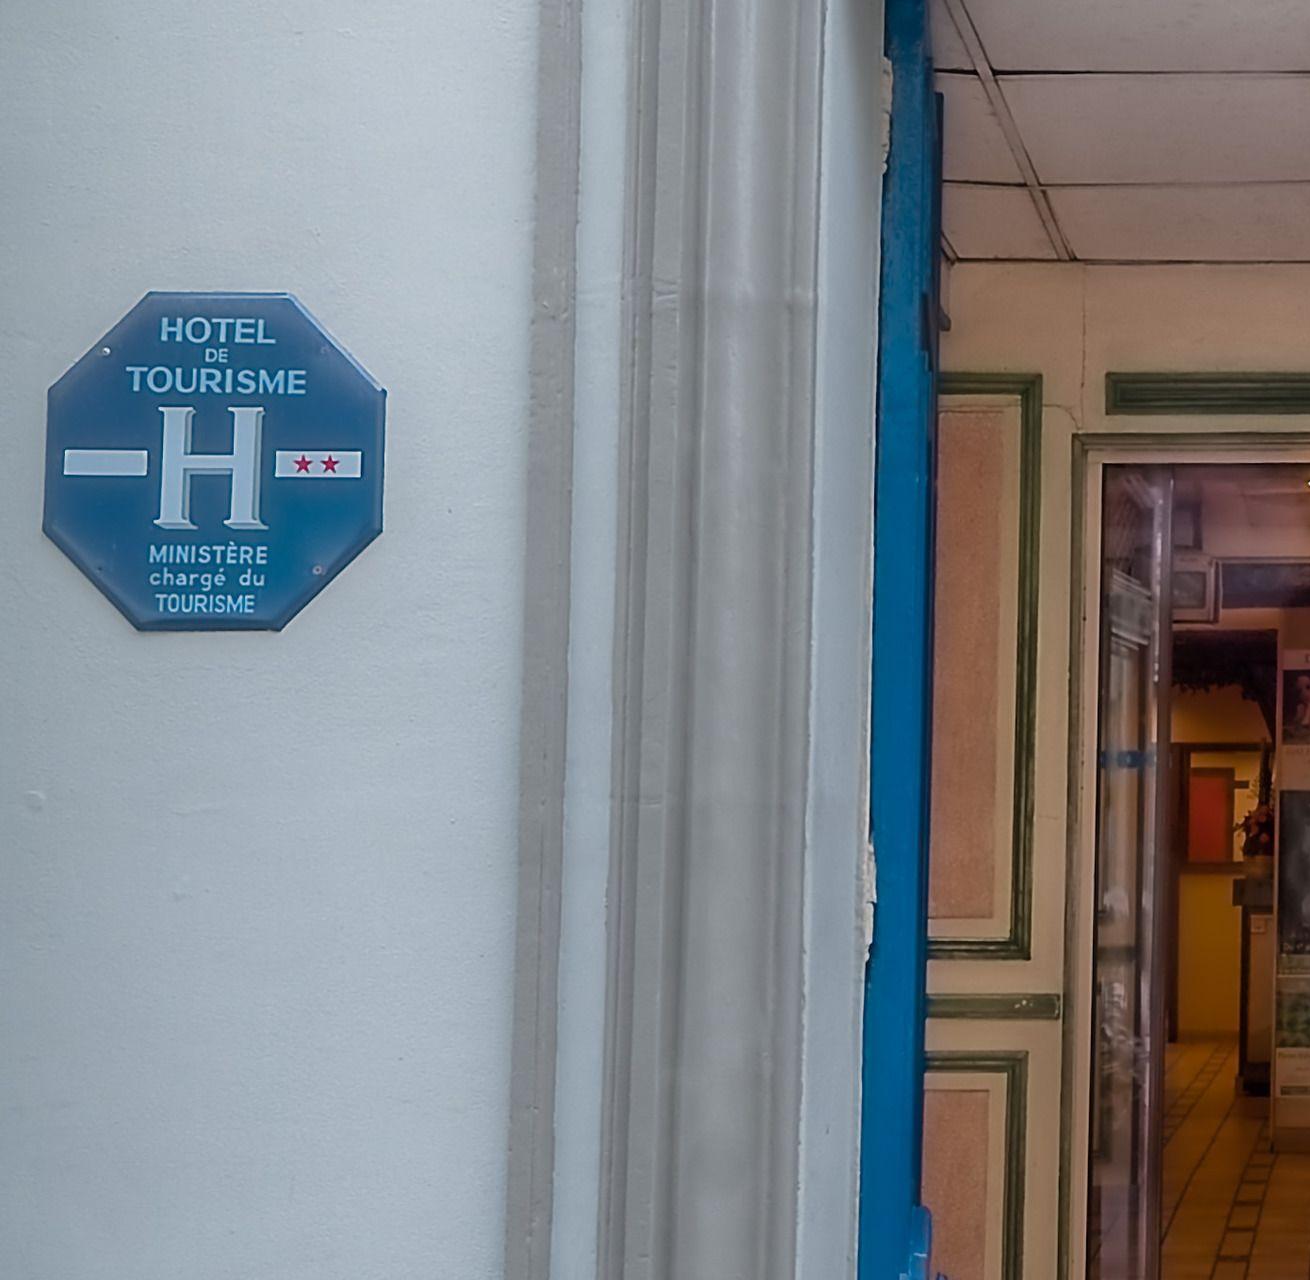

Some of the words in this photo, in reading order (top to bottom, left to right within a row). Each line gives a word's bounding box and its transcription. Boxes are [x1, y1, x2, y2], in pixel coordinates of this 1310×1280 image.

[160, 317, 276, 345] HOTEL
[205, 349, 229, 364] DE
[126, 366, 307, 395] TOURISME
[153, 406, 269, 530] H
[149, 541, 268, 565] MINISTÈRE
[149, 568, 226, 592] chargé
[239, 570, 265, 587] du
[155, 595, 255, 613] TOURISME
